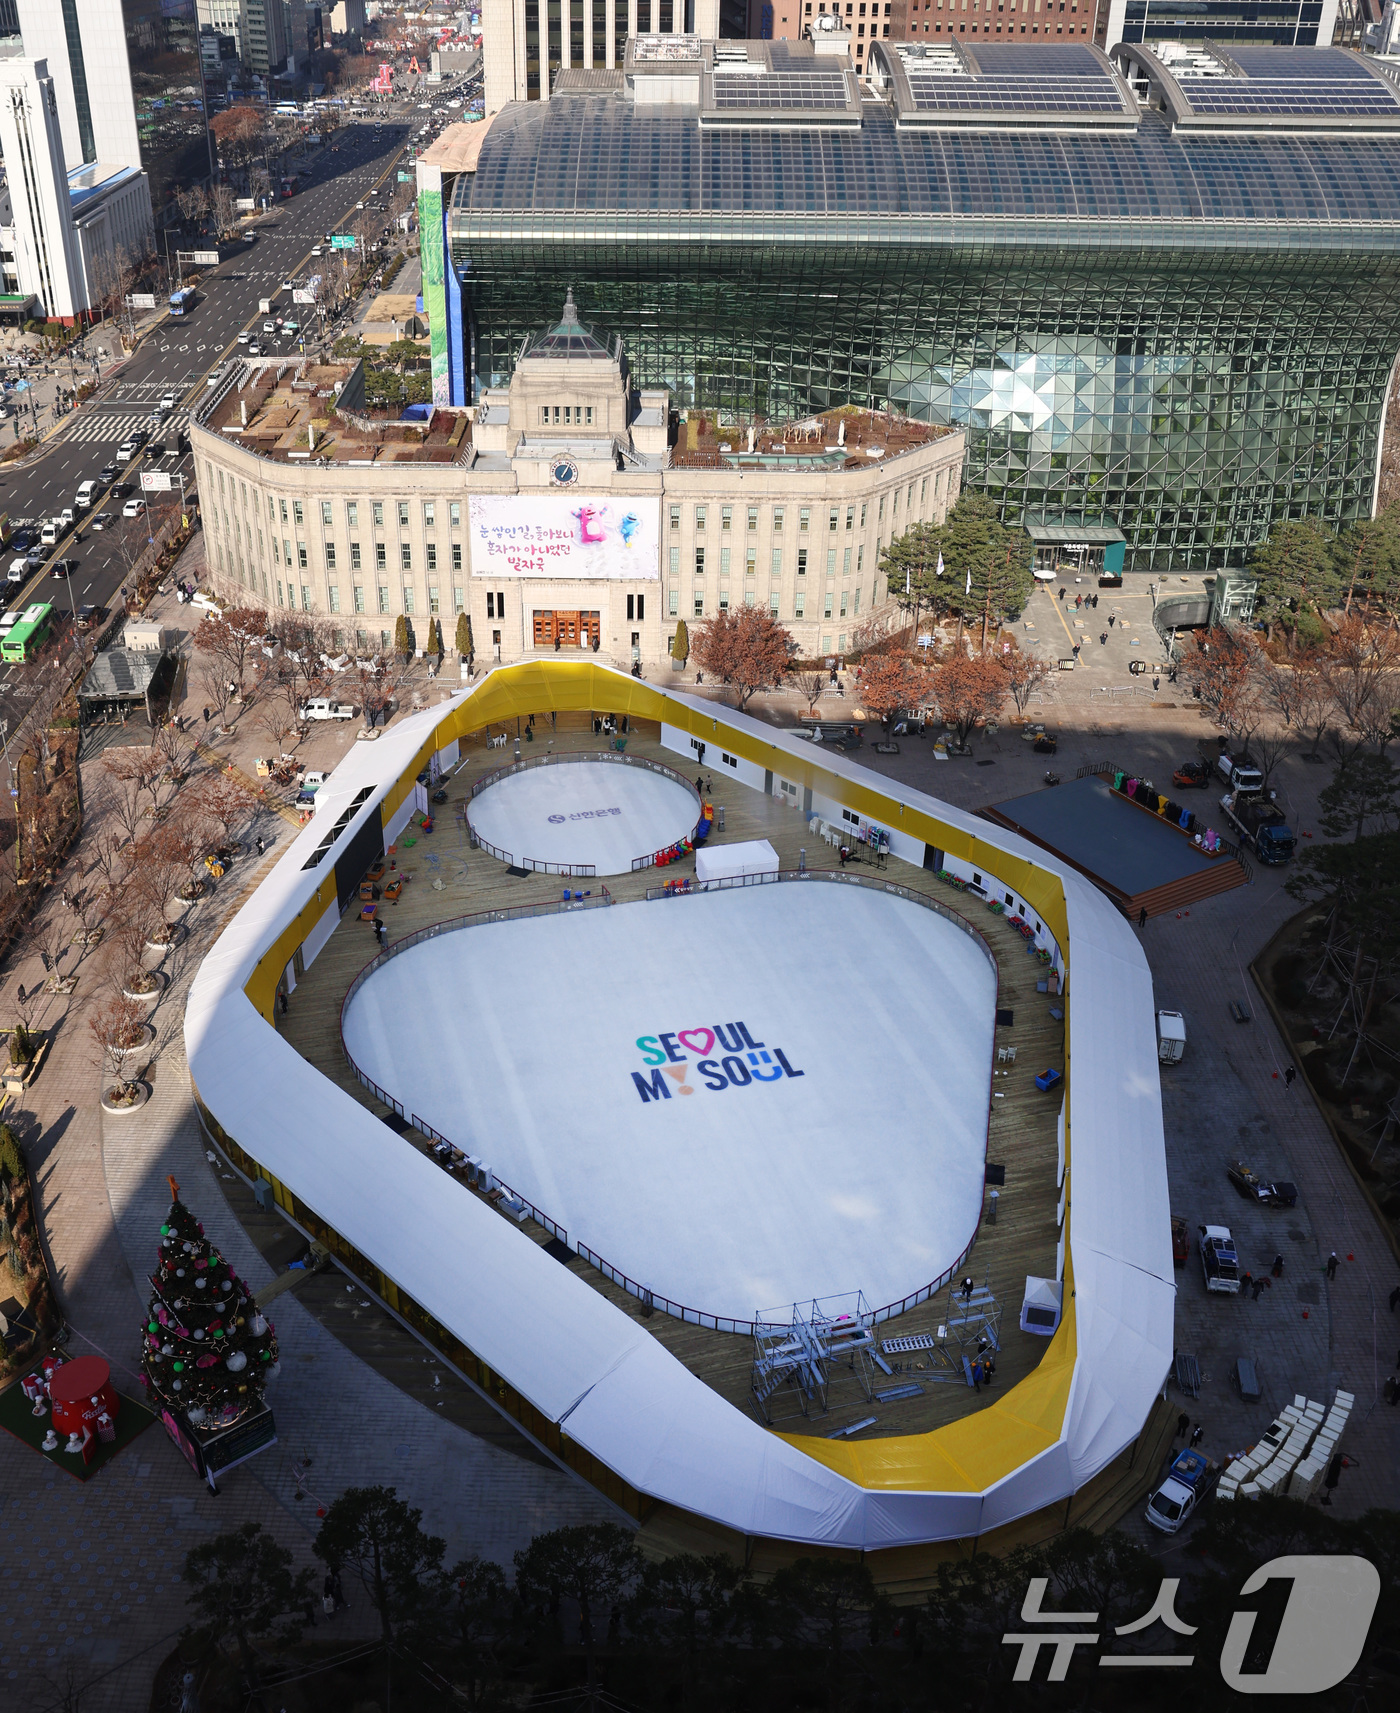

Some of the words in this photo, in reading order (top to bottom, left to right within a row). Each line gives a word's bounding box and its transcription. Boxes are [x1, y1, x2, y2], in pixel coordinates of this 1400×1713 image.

[480, 525, 489, 538] 눈
[492, 525, 516, 539] 쌓인
[536, 526, 573, 540] 돌아보니
[487, 540, 520, 556] 혼자가
[524, 544, 570, 556] 아니었던
[508, 556, 544, 572] 발자국
[568, 808, 621, 820] 신한은행
